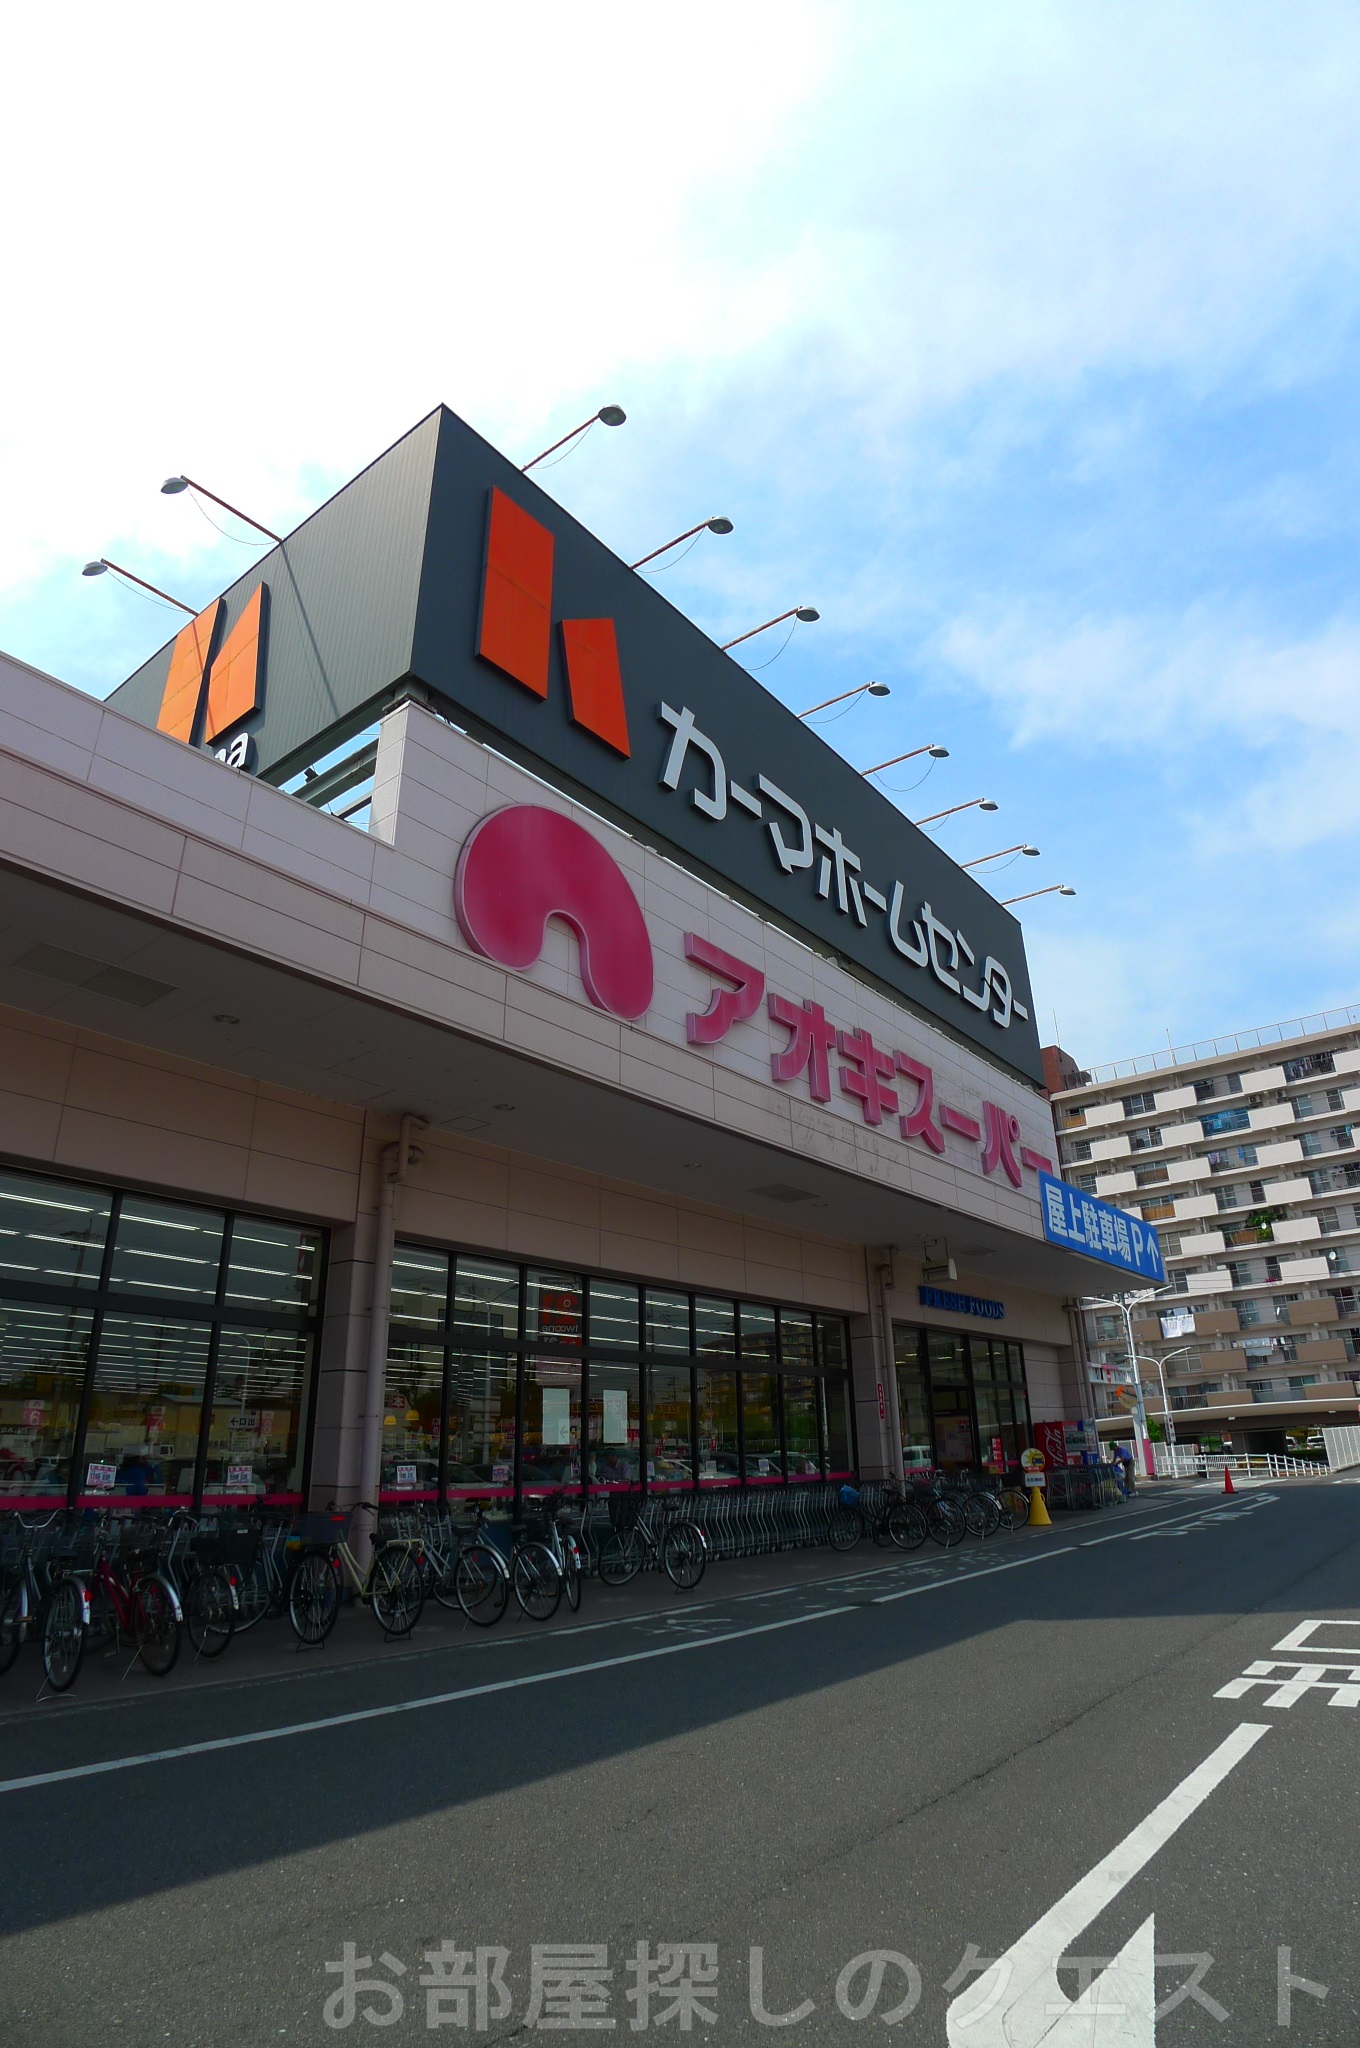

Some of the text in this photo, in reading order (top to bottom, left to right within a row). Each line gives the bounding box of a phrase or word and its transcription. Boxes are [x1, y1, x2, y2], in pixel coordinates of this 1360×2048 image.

[657, 701, 1029, 1029] カーマホームセンター
[684, 931, 1053, 1188] アオキスーパー
[921, 1286, 1006, 1319] FRESH FOODS
[29, 1411, 41, 1426] 6
[153, 1413, 165, 1431] 7
